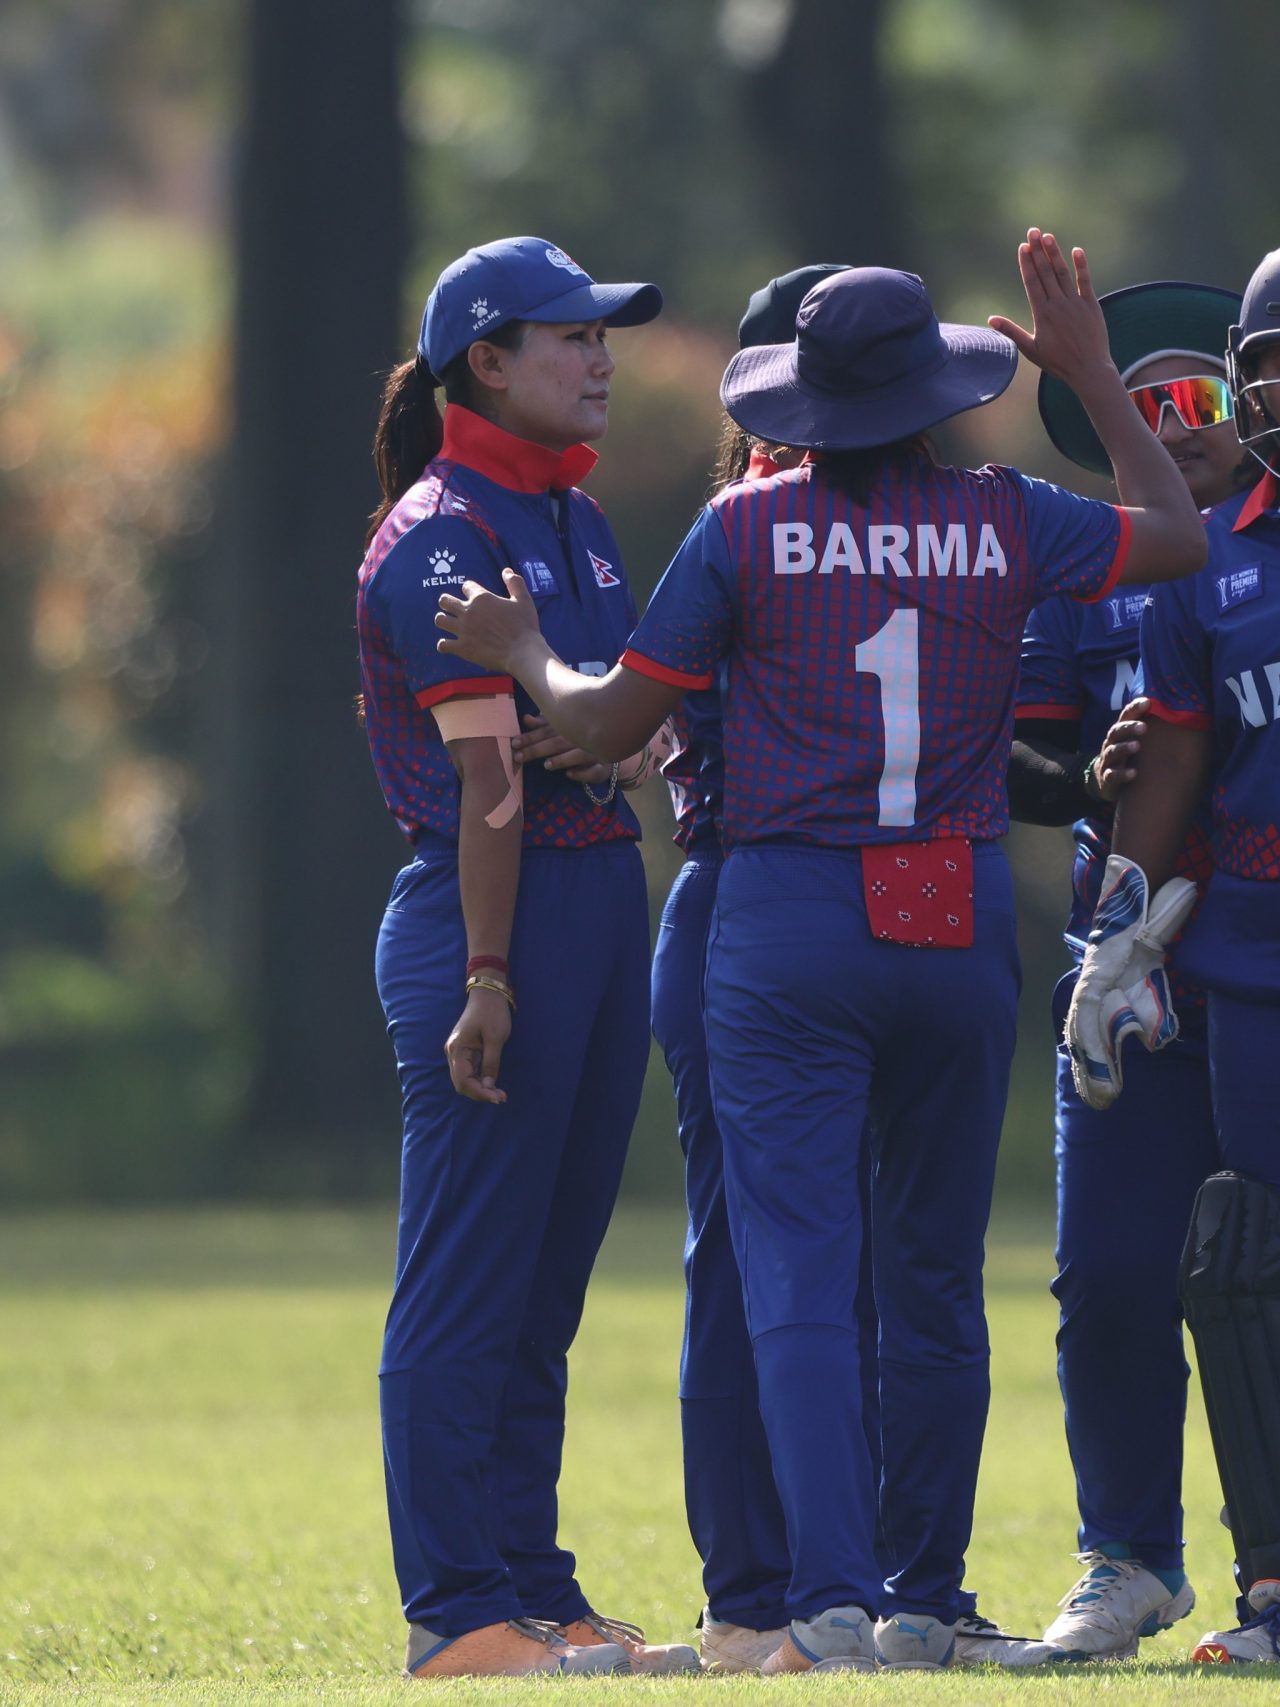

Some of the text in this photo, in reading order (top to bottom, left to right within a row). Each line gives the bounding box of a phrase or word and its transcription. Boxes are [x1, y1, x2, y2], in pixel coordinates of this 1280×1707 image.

[472, 309, 501, 332] KELME
[772, 522, 1008, 578] BARMA
[422, 575, 466, 588] KELME
[1231, 574, 1258, 592] PREMIER
[855, 607, 920, 828] 1
